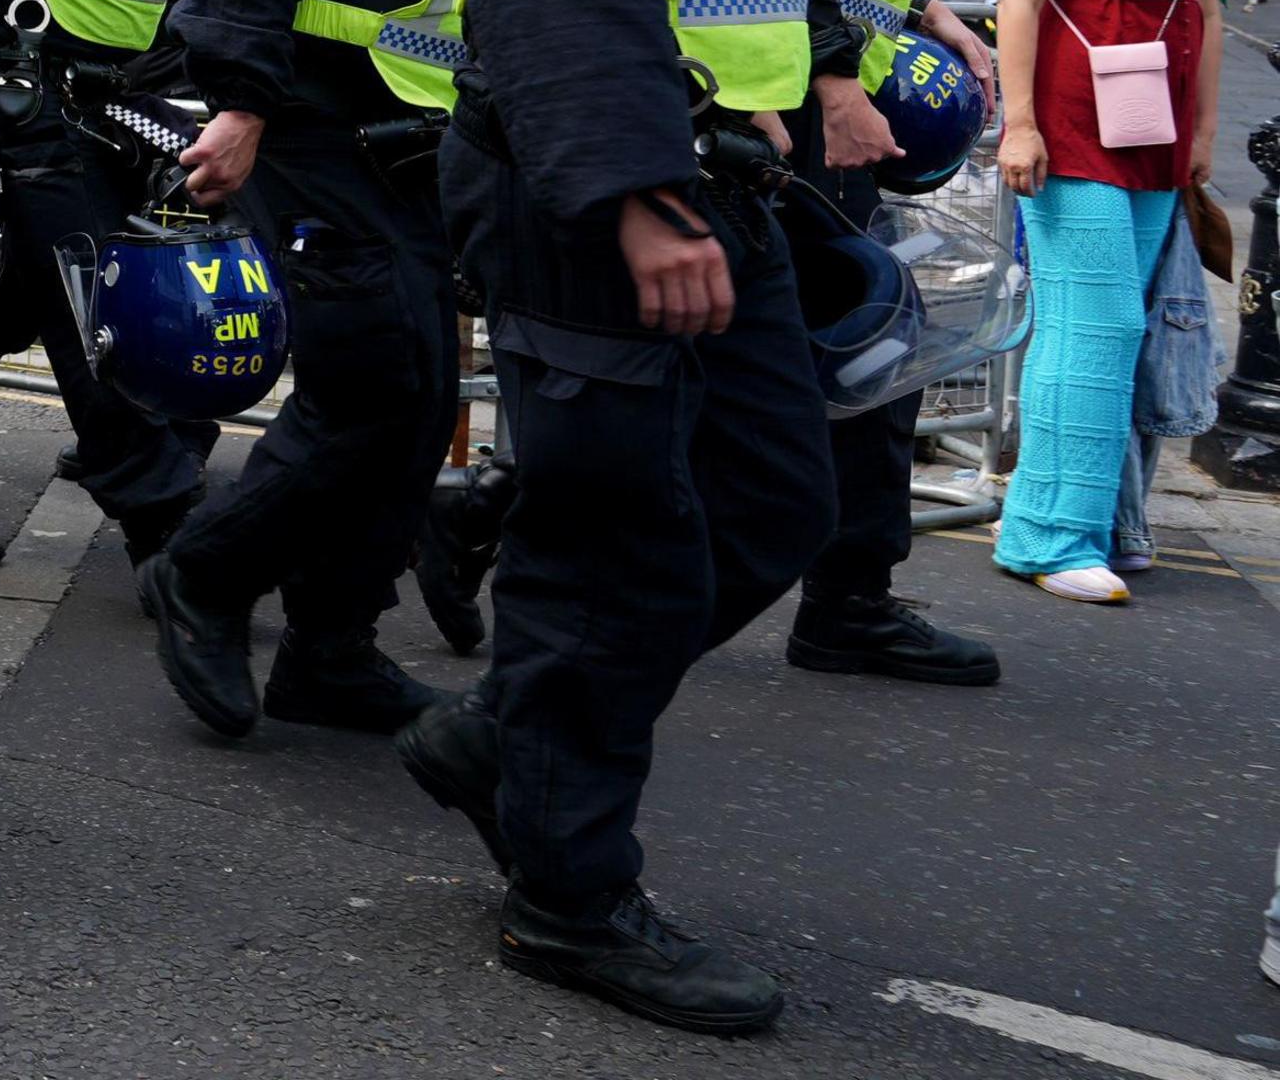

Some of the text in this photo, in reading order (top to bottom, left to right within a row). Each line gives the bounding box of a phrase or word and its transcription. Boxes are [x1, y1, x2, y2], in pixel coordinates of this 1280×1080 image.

[910, 50, 941, 86] MP
[924, 63, 962, 110] 2872
[214, 312, 260, 342] MP
[192, 354, 263, 376] 0253
